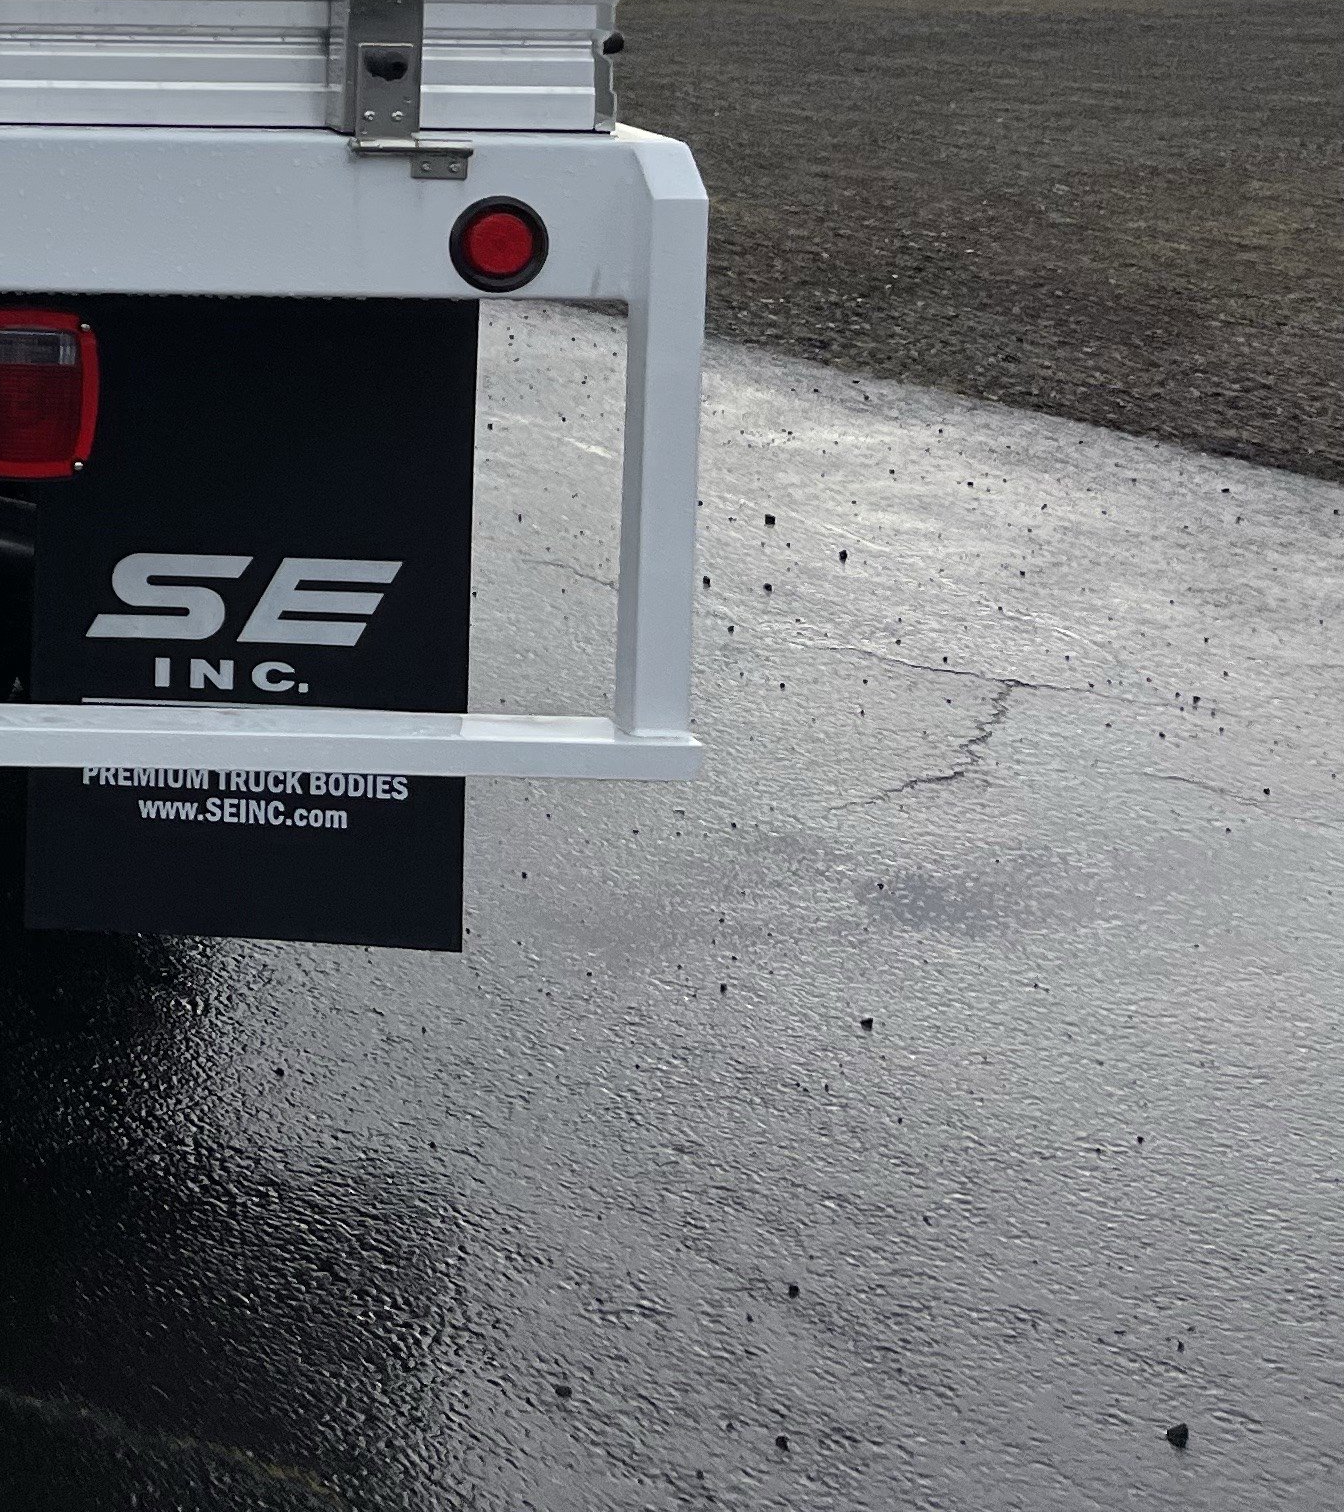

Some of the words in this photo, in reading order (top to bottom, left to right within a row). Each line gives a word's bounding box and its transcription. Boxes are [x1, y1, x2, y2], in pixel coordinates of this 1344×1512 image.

[85, 551, 403, 647] SE
[154, 656, 310, 694] INC.
[81, 766, 210, 789] PREMIUM
[215, 768, 304, 795] TRUCK
[309, 773, 410, 801] BODIES
[137, 797, 349, 830] www.SEINC.com
